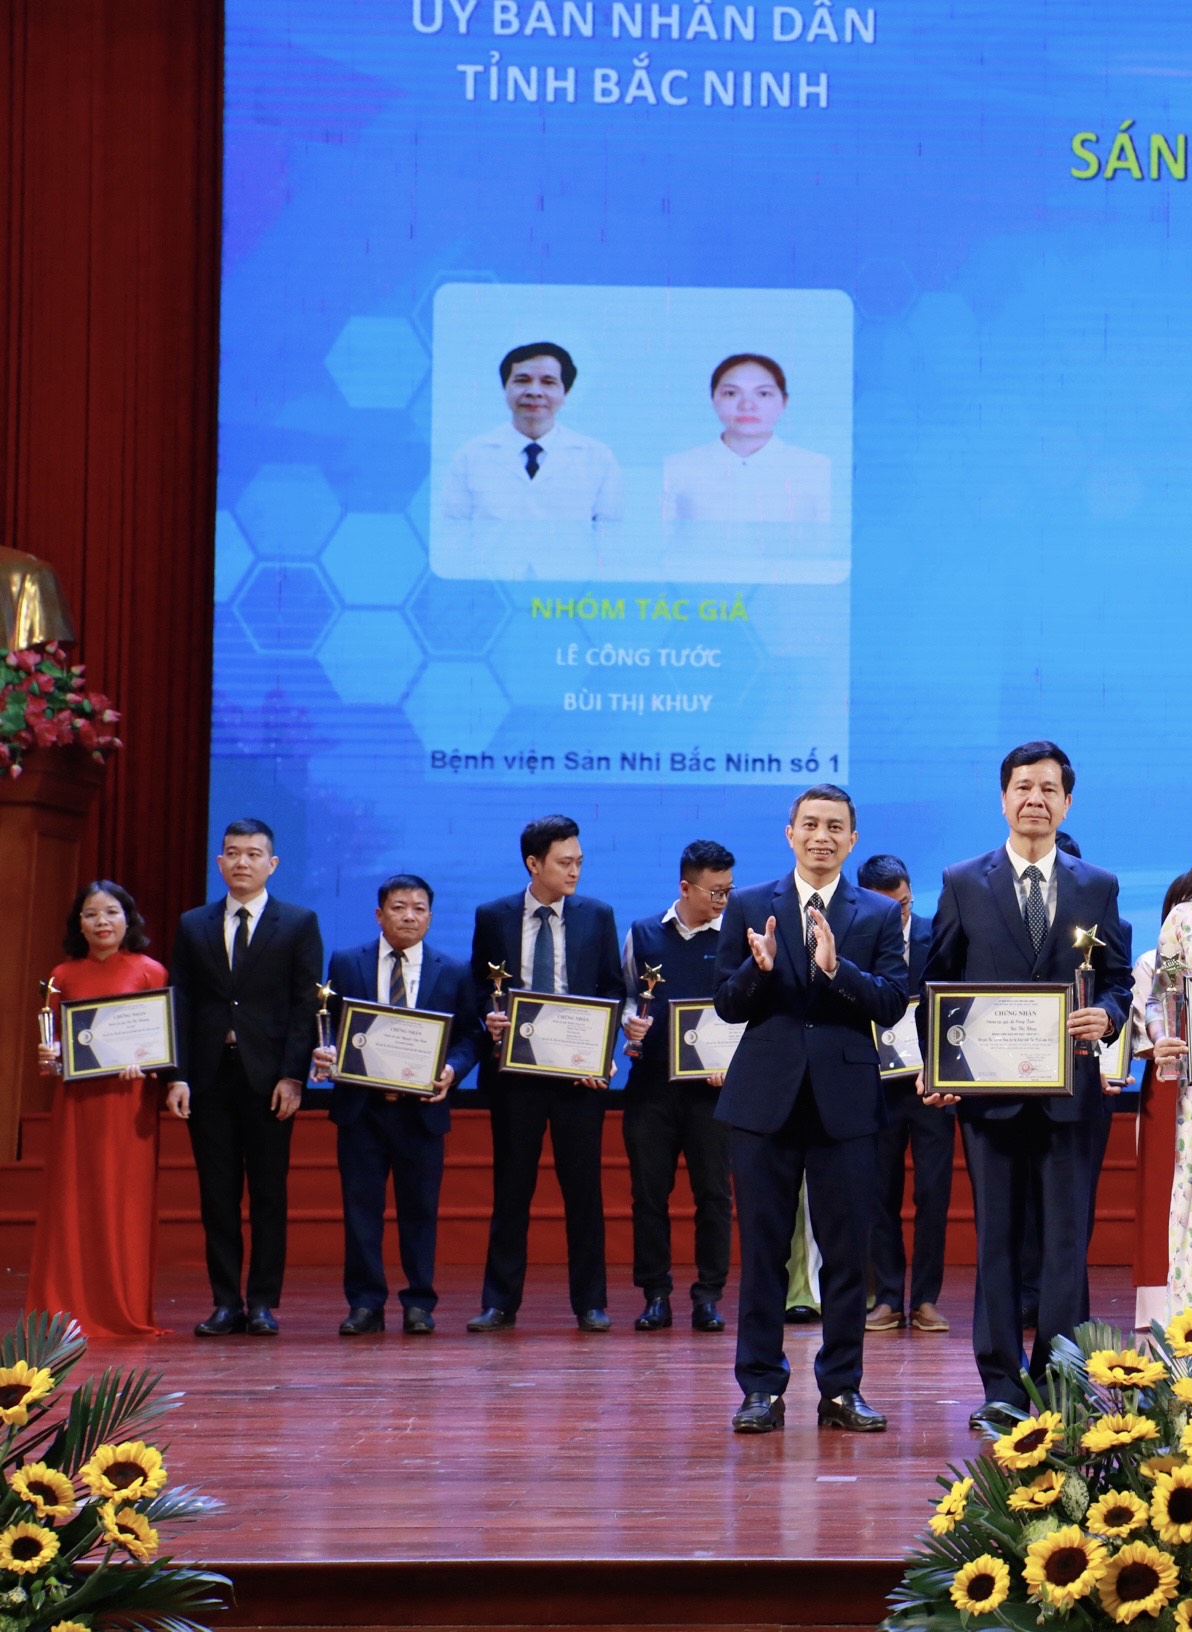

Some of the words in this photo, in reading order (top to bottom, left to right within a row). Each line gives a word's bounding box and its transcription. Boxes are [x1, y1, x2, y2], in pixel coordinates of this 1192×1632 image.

[493, 0, 593, 37] BAN
[773, 0, 876, 43] DÂN
[457, 51, 576, 103] TỈNH
[593, 51, 688, 106] BẮC
[704, 70, 829, 108] NINH
[531, 594, 625, 620] NHÓM
[635, 594, 690, 621] TÁC
[700, 594, 749, 622] GIẢ
[556, 644, 579, 667] LÊ
[585, 645, 650, 667] CÔNG
[658, 646, 722, 668] TƯỚC
[564, 689, 601, 712] BÙI
[608, 693, 645, 716] THỊ
[651, 693, 714, 712] KHUY
[431, 748, 494, 773] Bệnh
[504, 749, 555, 774] viện
[564, 749, 611, 772] Sản
[620, 751, 661, 773] Nhi
[670, 745, 717, 773] Bắc
[726, 751, 782, 774] Ninh
[790, 747, 820, 774] số
[829, 753, 840, 773] 1
